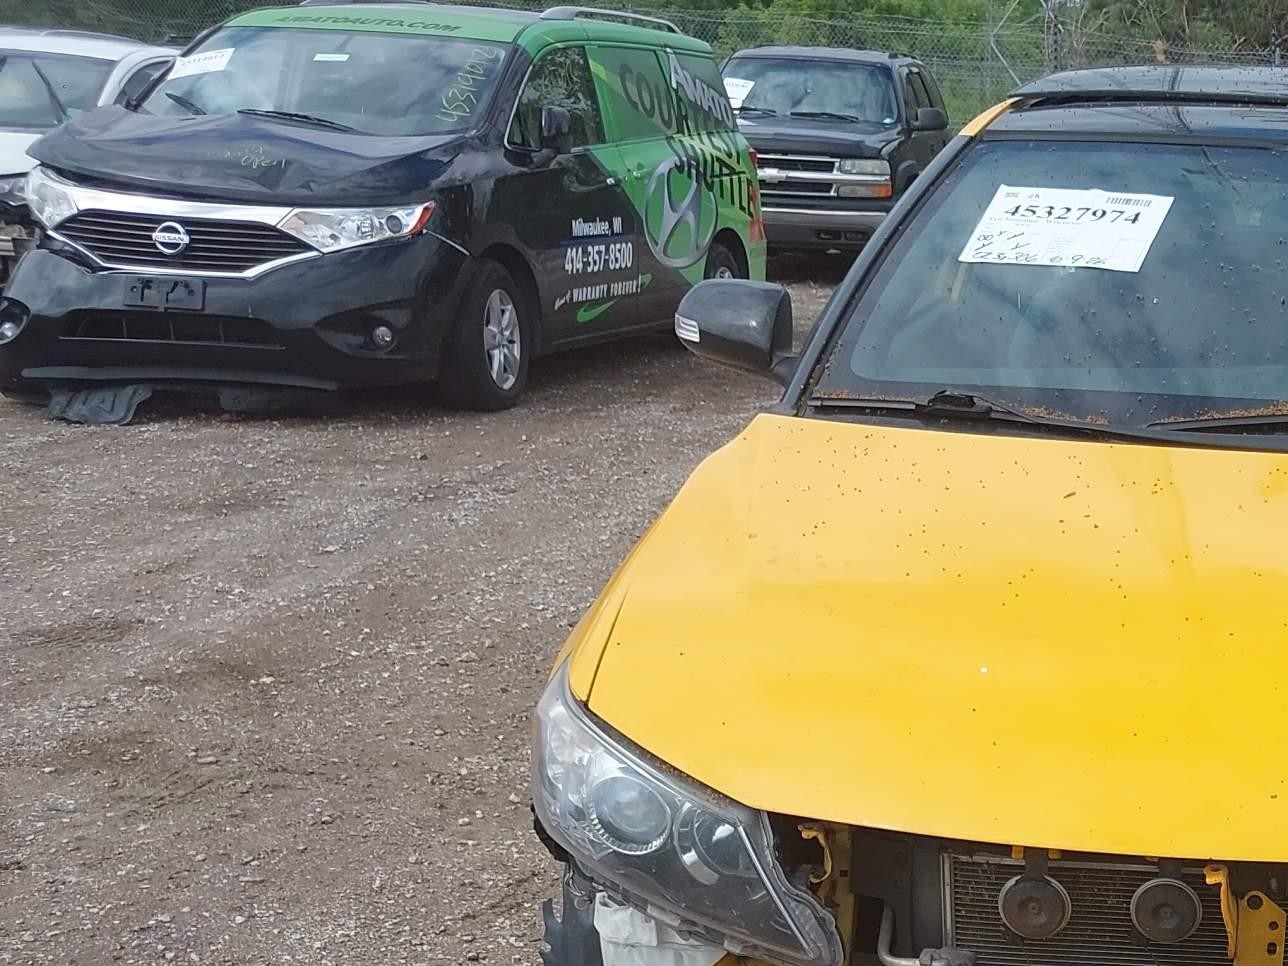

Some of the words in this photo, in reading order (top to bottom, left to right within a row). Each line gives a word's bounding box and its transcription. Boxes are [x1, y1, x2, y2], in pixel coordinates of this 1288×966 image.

[273, 16, 463, 32] AMATOAUTO.COM
[666, 47, 735, 128] AMATO
[1003, 203, 1143, 225] 45327974
[154, 233, 185, 242] NISSAN
[572, 217, 611, 238] Milwaukee,
[613, 216, 623, 235] WI
[565, 242, 633, 275] 414-357-8500
[573, 284, 608, 303] WARRANTY
[610, 273, 641, 297] FOREVER!
